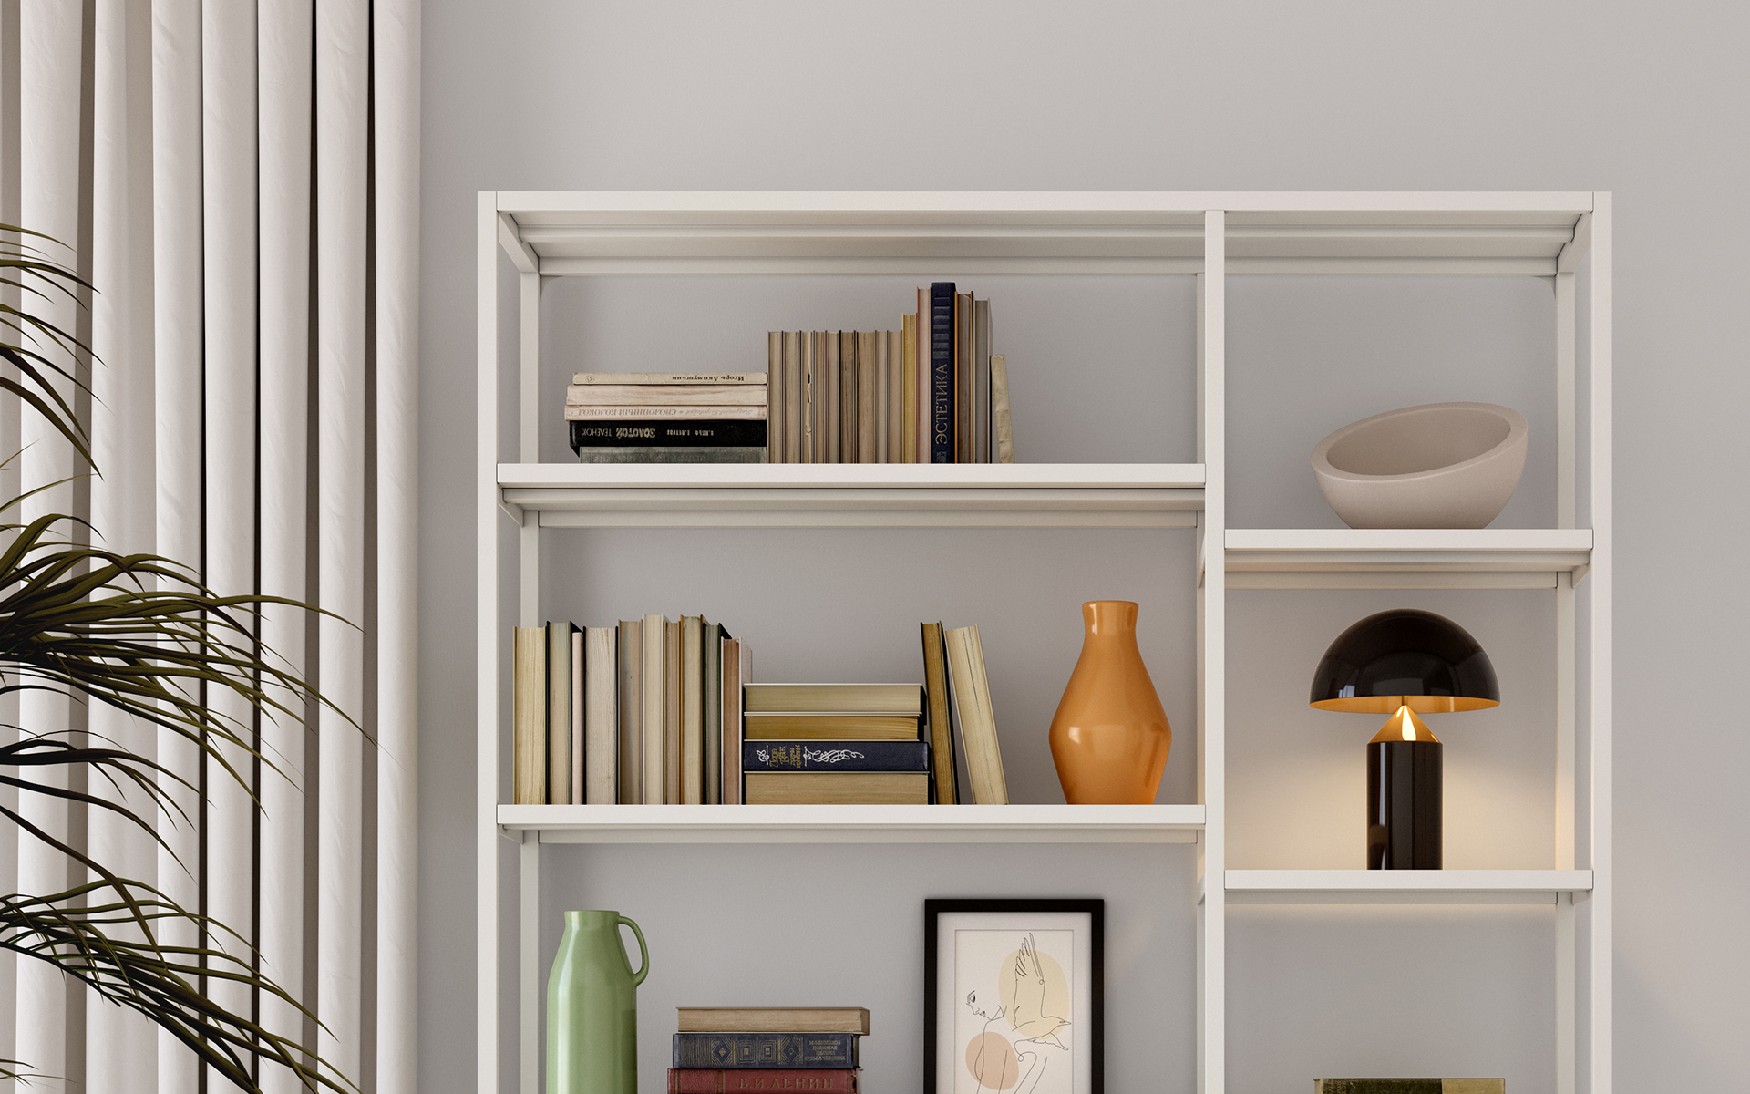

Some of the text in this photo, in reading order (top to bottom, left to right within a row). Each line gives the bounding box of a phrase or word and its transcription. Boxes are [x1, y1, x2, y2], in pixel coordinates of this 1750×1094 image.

[935, 364, 948, 445] ЭСТЕТИКА
[581, 427, 612, 437] ТЕЛЕНОК
[615, 427, 656, 439] ЗОЛОТОЙ
